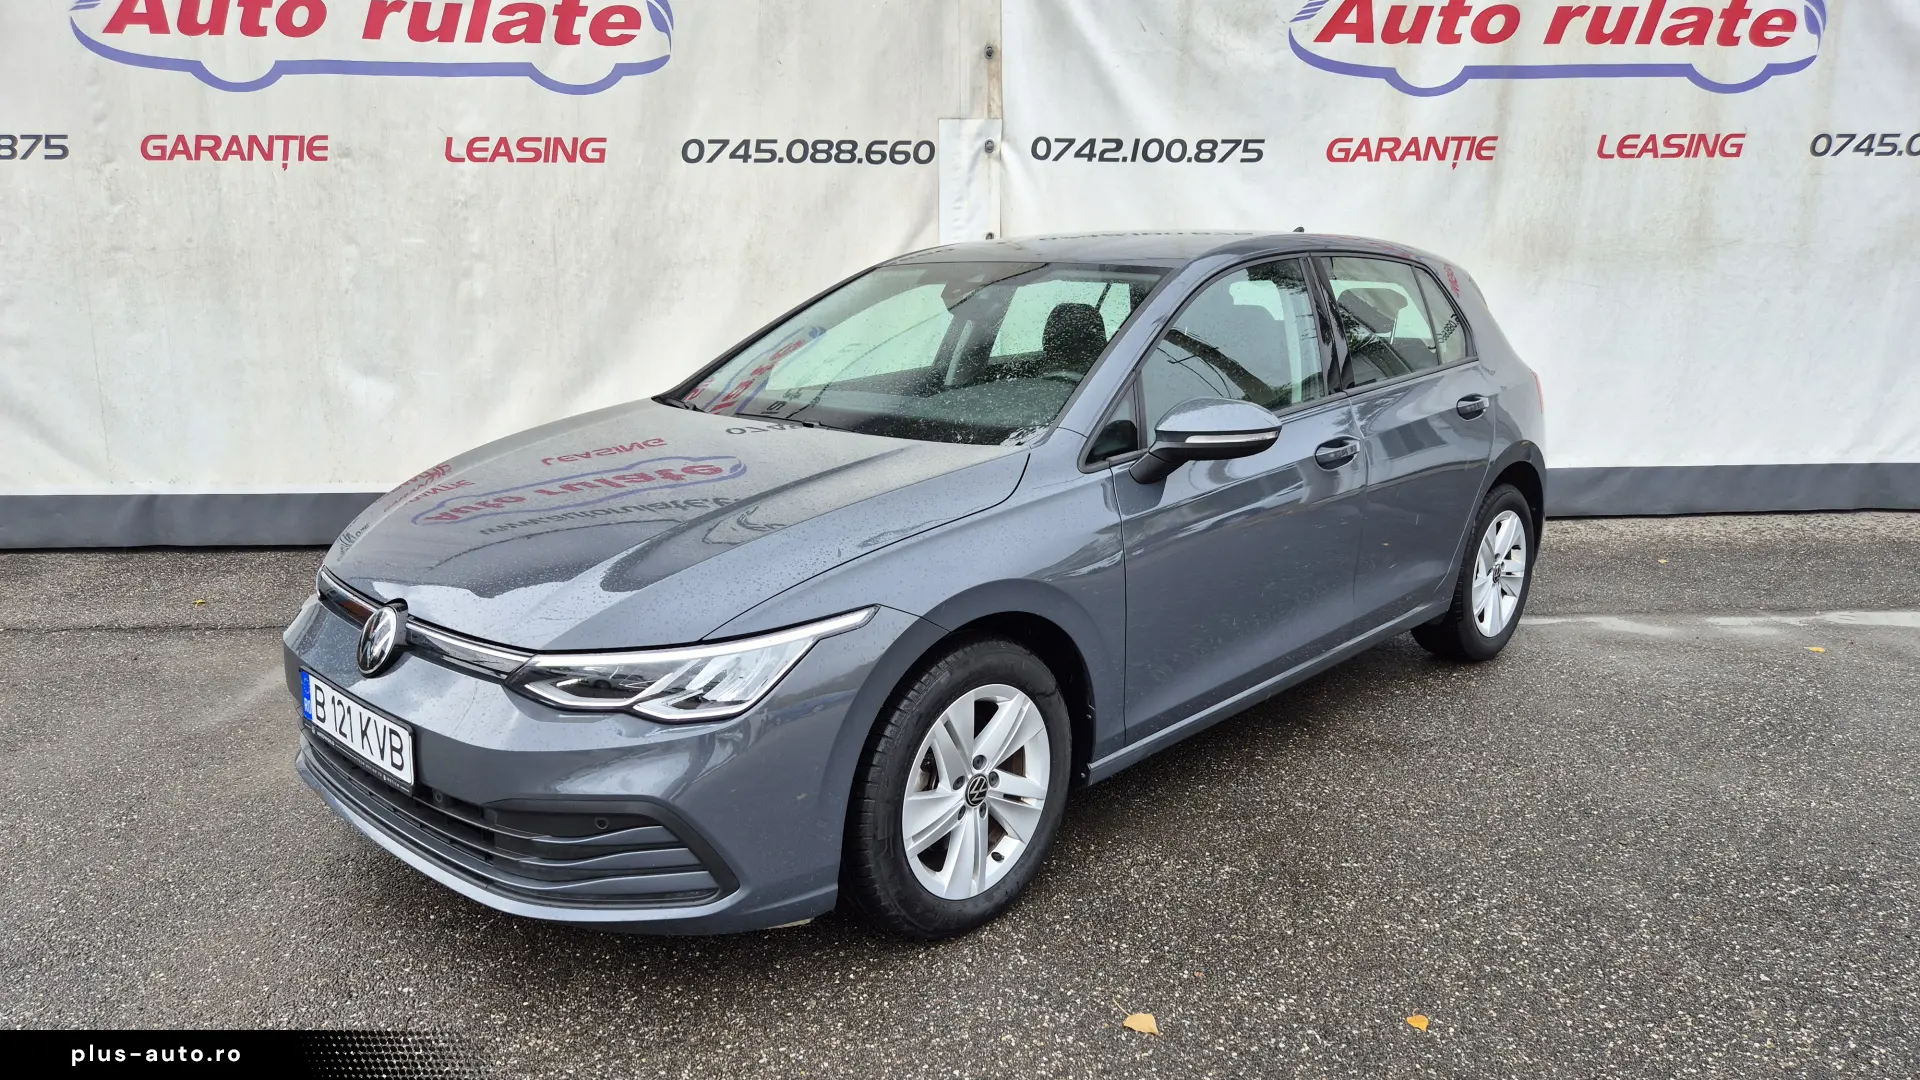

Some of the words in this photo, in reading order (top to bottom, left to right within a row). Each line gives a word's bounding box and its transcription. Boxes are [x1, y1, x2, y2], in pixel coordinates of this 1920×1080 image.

[104, 0, 327, 39] Auto
[362, 0, 642, 47] rulate
[1313, 0, 1521, 45] Auto
[1544, 0, 1797, 47] rulate
[0, 134, 69, 160] 875
[140, 134, 329, 170] GARANȚIE
[445, 136, 607, 164] LEASING
[682, 139, 936, 165] 0745.088.660
[1031, 137, 1266, 163] 0742.100.875
[1326, 136, 1499, 169] GARANȚIE
[1597, 133, 1746, 160] LEASING
[314, 683, 327, 725] B
[331, 695, 354, 744] 121
[359, 711, 405, 772] KVB
